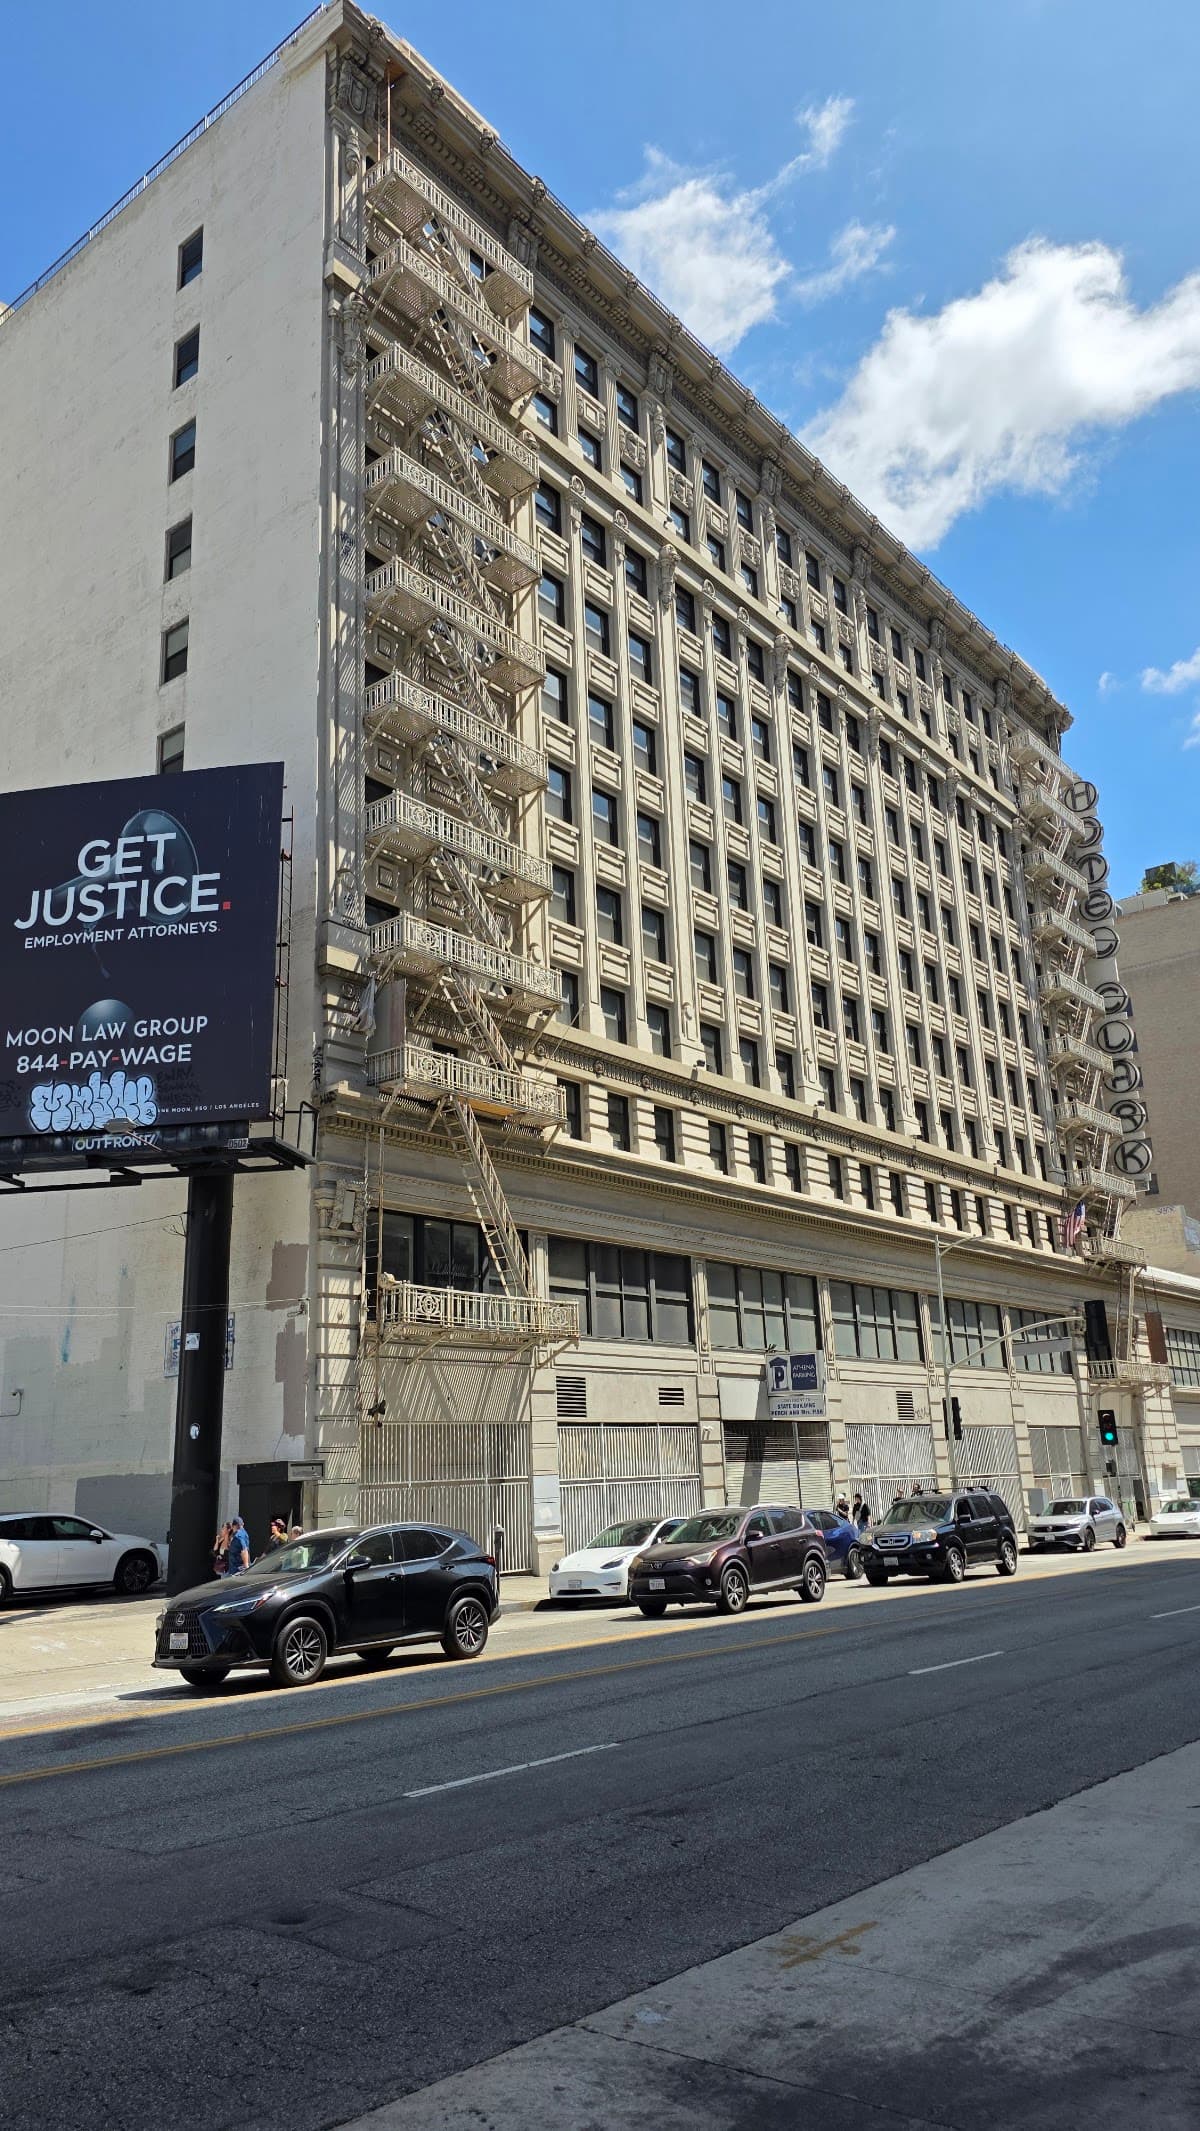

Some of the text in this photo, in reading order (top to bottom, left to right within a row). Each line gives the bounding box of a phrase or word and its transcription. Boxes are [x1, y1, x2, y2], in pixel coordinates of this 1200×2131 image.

[77, 832, 177, 878] GET
[14, 872, 231, 930] JUSTICE.
[24, 929, 125, 949] EMPLOYMENT
[6, 1015, 209, 1048] MOON LAW GROUP
[16, 1043, 193, 1074] 844-PAY-WAGE
[774, 1367, 785, 1388] P
